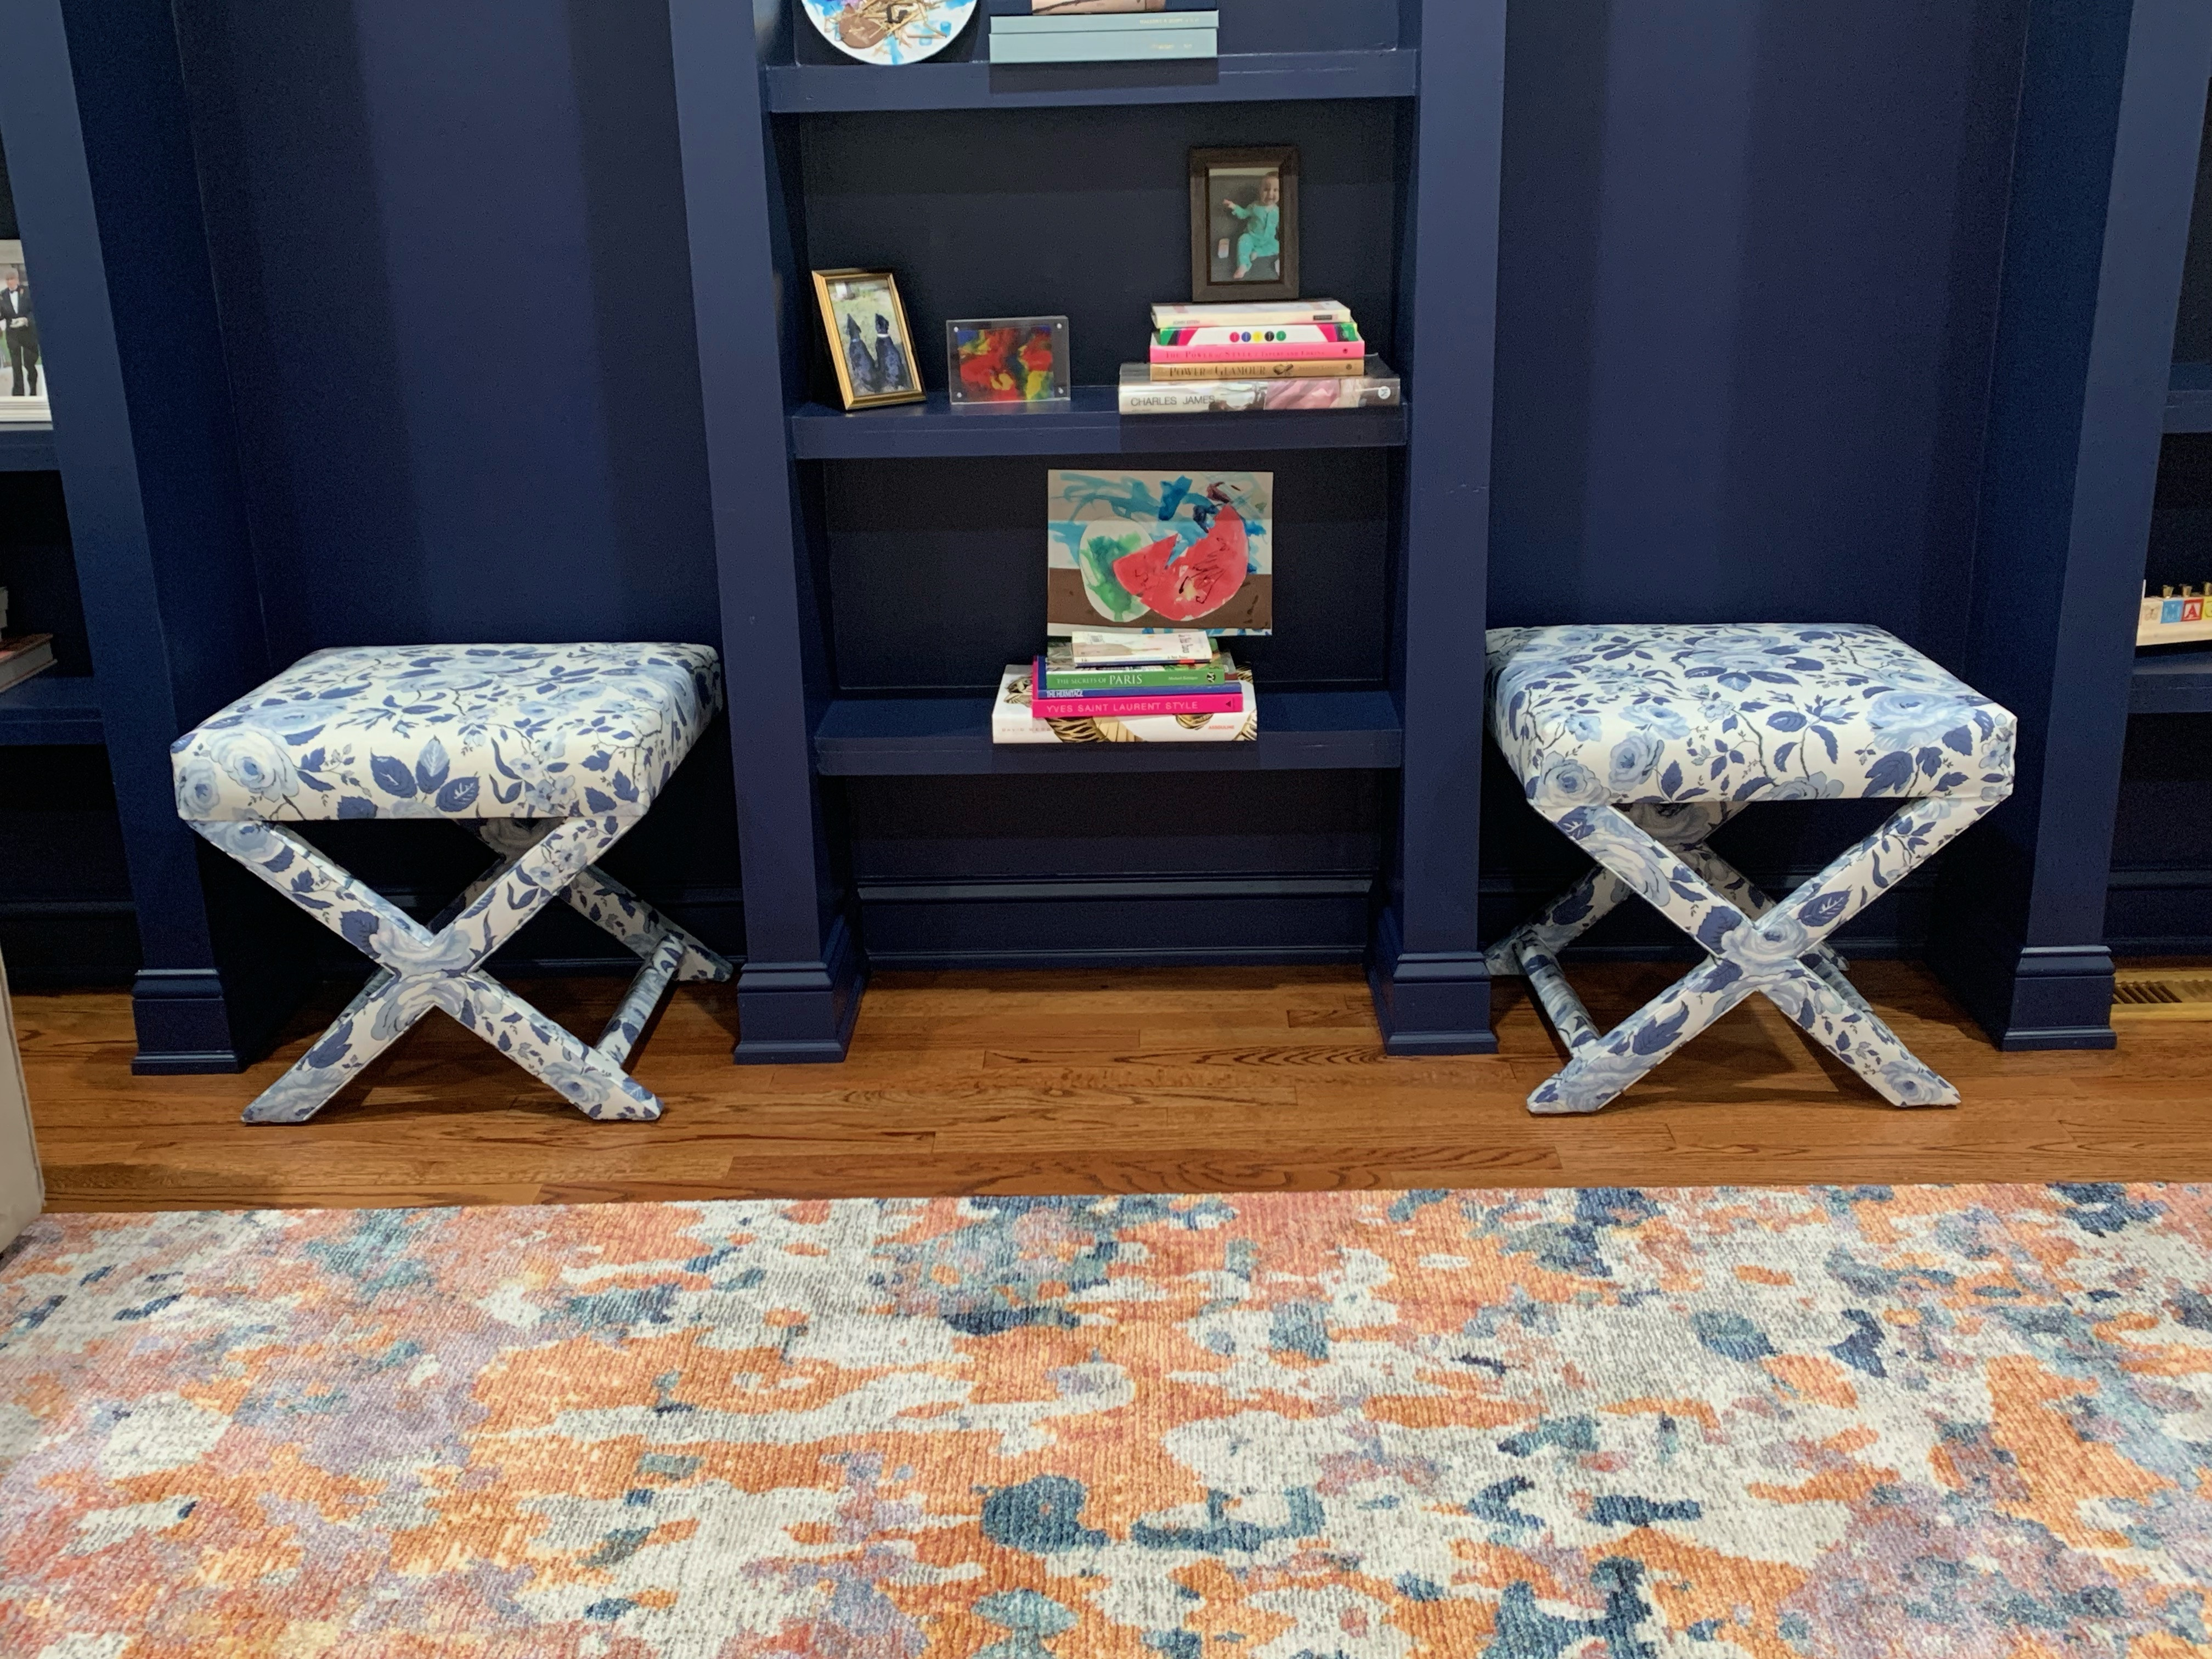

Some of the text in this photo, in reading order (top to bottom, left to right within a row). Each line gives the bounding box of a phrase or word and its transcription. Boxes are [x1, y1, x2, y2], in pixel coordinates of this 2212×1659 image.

[1170, 366, 1206, 377] POWER
[1215, 364, 1266, 376] GLAMOUR
[1131, 394, 1216, 407] CHARLES JAMES
[1109, 674, 1142, 685] PARIS
[1077, 703, 1108, 712] SAINT
[1113, 702, 1161, 712] LAURENT
[1165, 701, 1198, 709] STYLE
